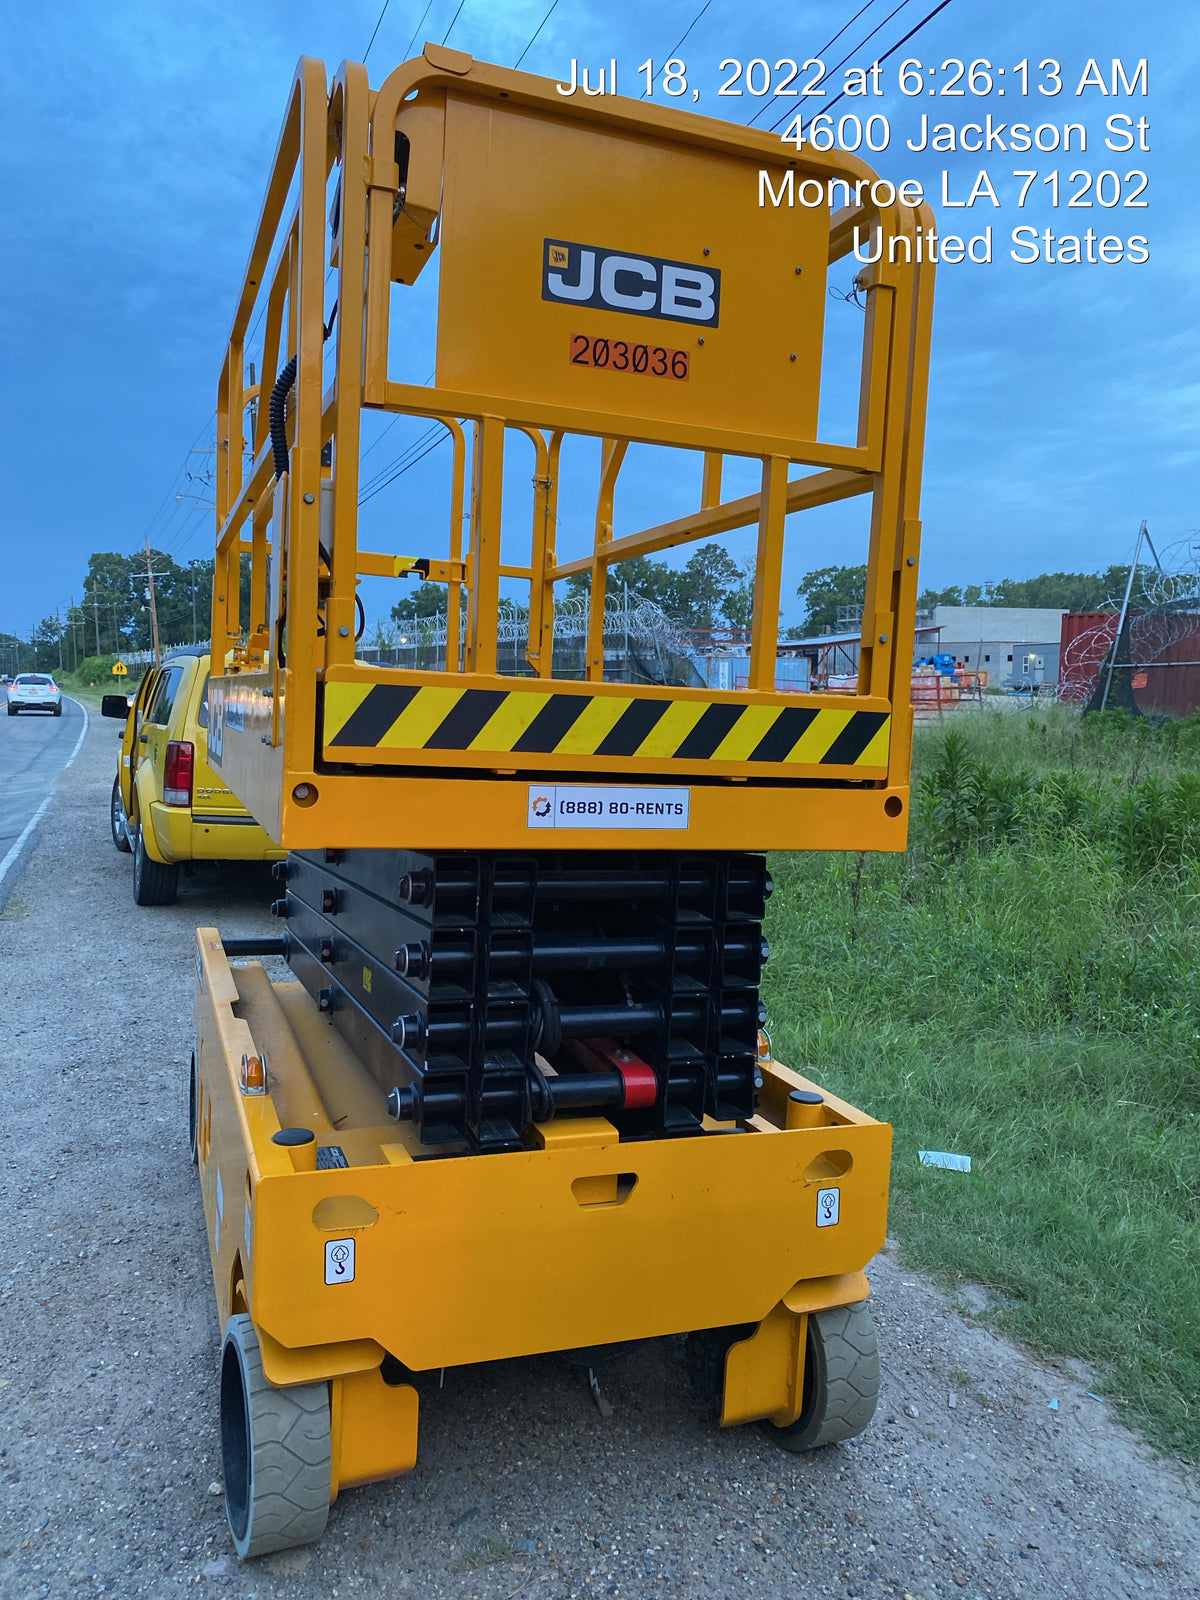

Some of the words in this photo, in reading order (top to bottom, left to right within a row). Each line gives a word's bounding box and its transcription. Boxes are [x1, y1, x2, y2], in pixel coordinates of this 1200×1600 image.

[547, 250, 715, 321] JCB
[572, 335, 688, 379] 203036
[560, 800, 603, 815] (888)
[609, 802, 683, 815] 80-RENTS
